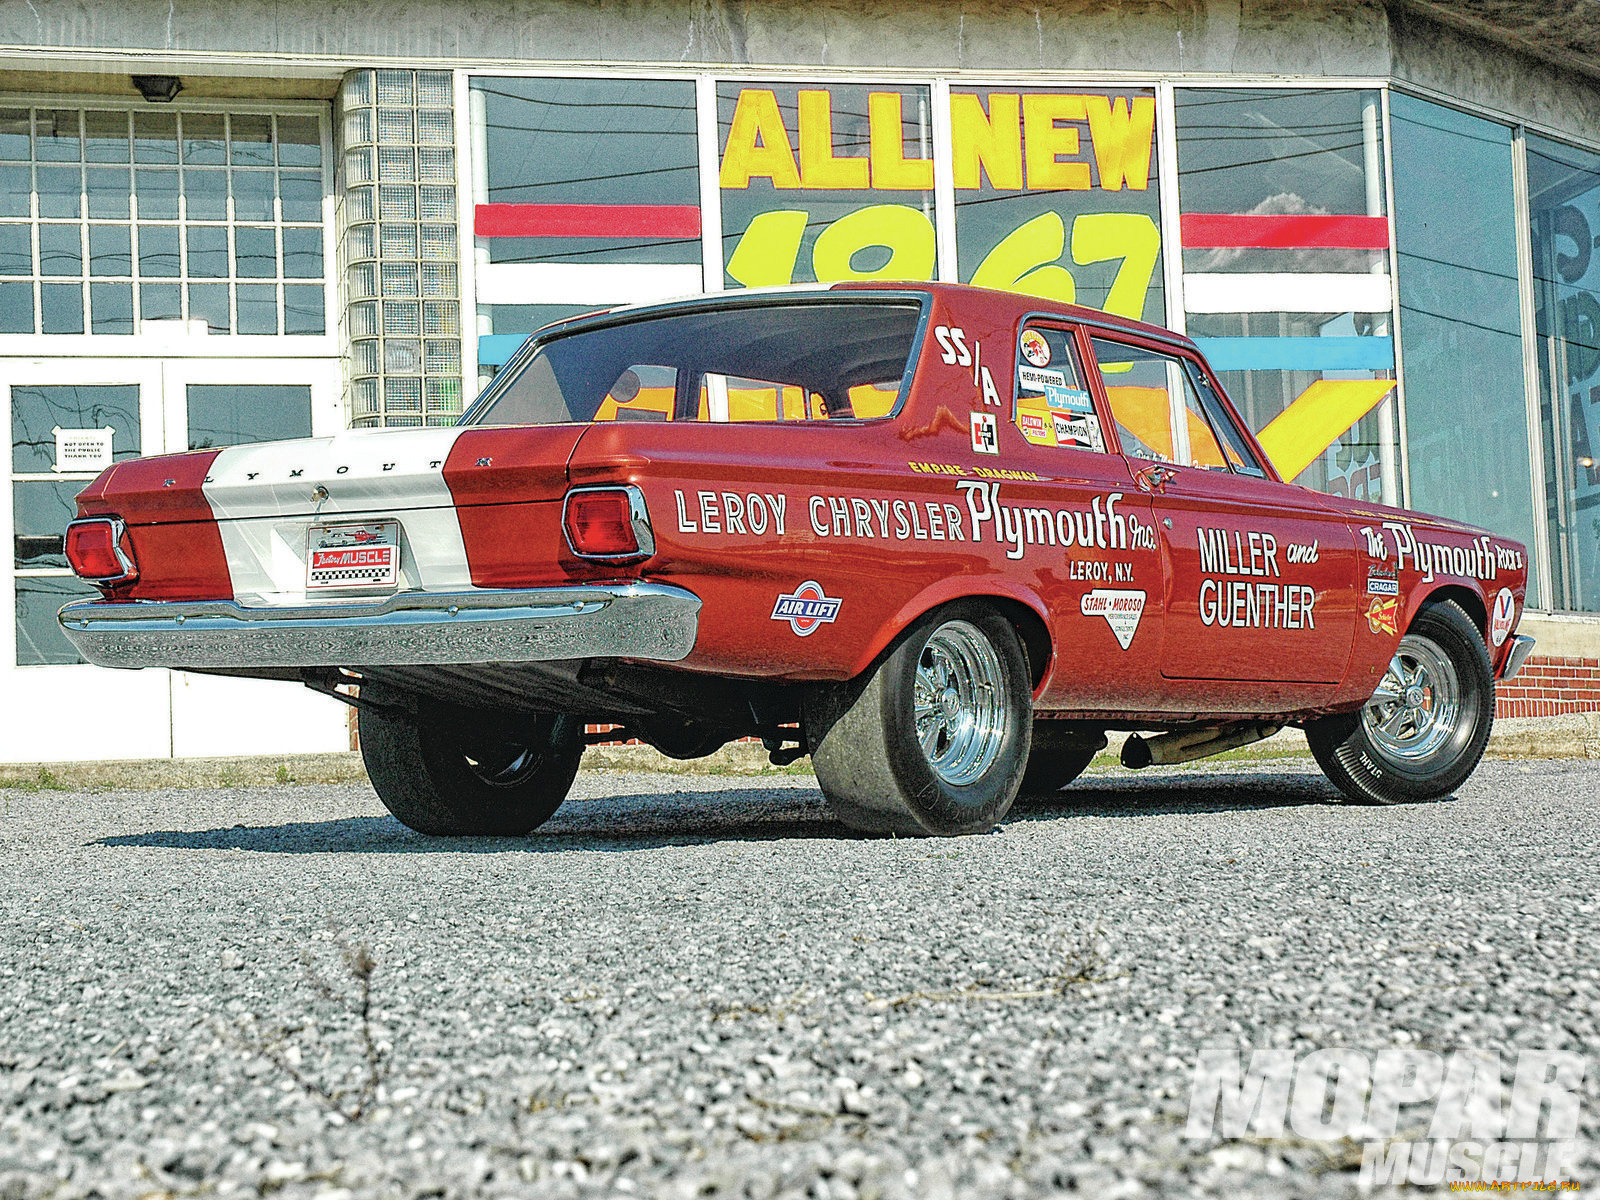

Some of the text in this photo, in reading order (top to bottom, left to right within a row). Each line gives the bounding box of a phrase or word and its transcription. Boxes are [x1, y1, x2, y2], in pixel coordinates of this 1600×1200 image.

[718, 88, 1156, 191] ALL NEW
[1022, 371, 1063, 386] HEMI-POWERED
[1046, 386, 1090, 408] Plymouth
[1055, 422, 1088, 438] CHAMPION
[907, 461, 1041, 482] EMPIRE DRAGWAY
[674, 480, 1158, 560] LEROY CHRYSLER Plymouth Inc.
[314, 550, 390, 567] Factory MUSCLE
[1196, 526, 1320, 578] MILLER and
[1382, 521, 1497, 584] Plymouth
[1494, 544, 1517, 573] ROCK
[1068, 560, 1135, 585] LEROY, N.Y.
[1368, 581, 1398, 594] CRAGAR
[777, 600, 837, 617] AIR LIFT
[1083, 597, 1142, 611] STAHL MOROSO
[1199, 577, 1316, 630] GUENTHER
[1359, 750, 1383, 779] STAHL
